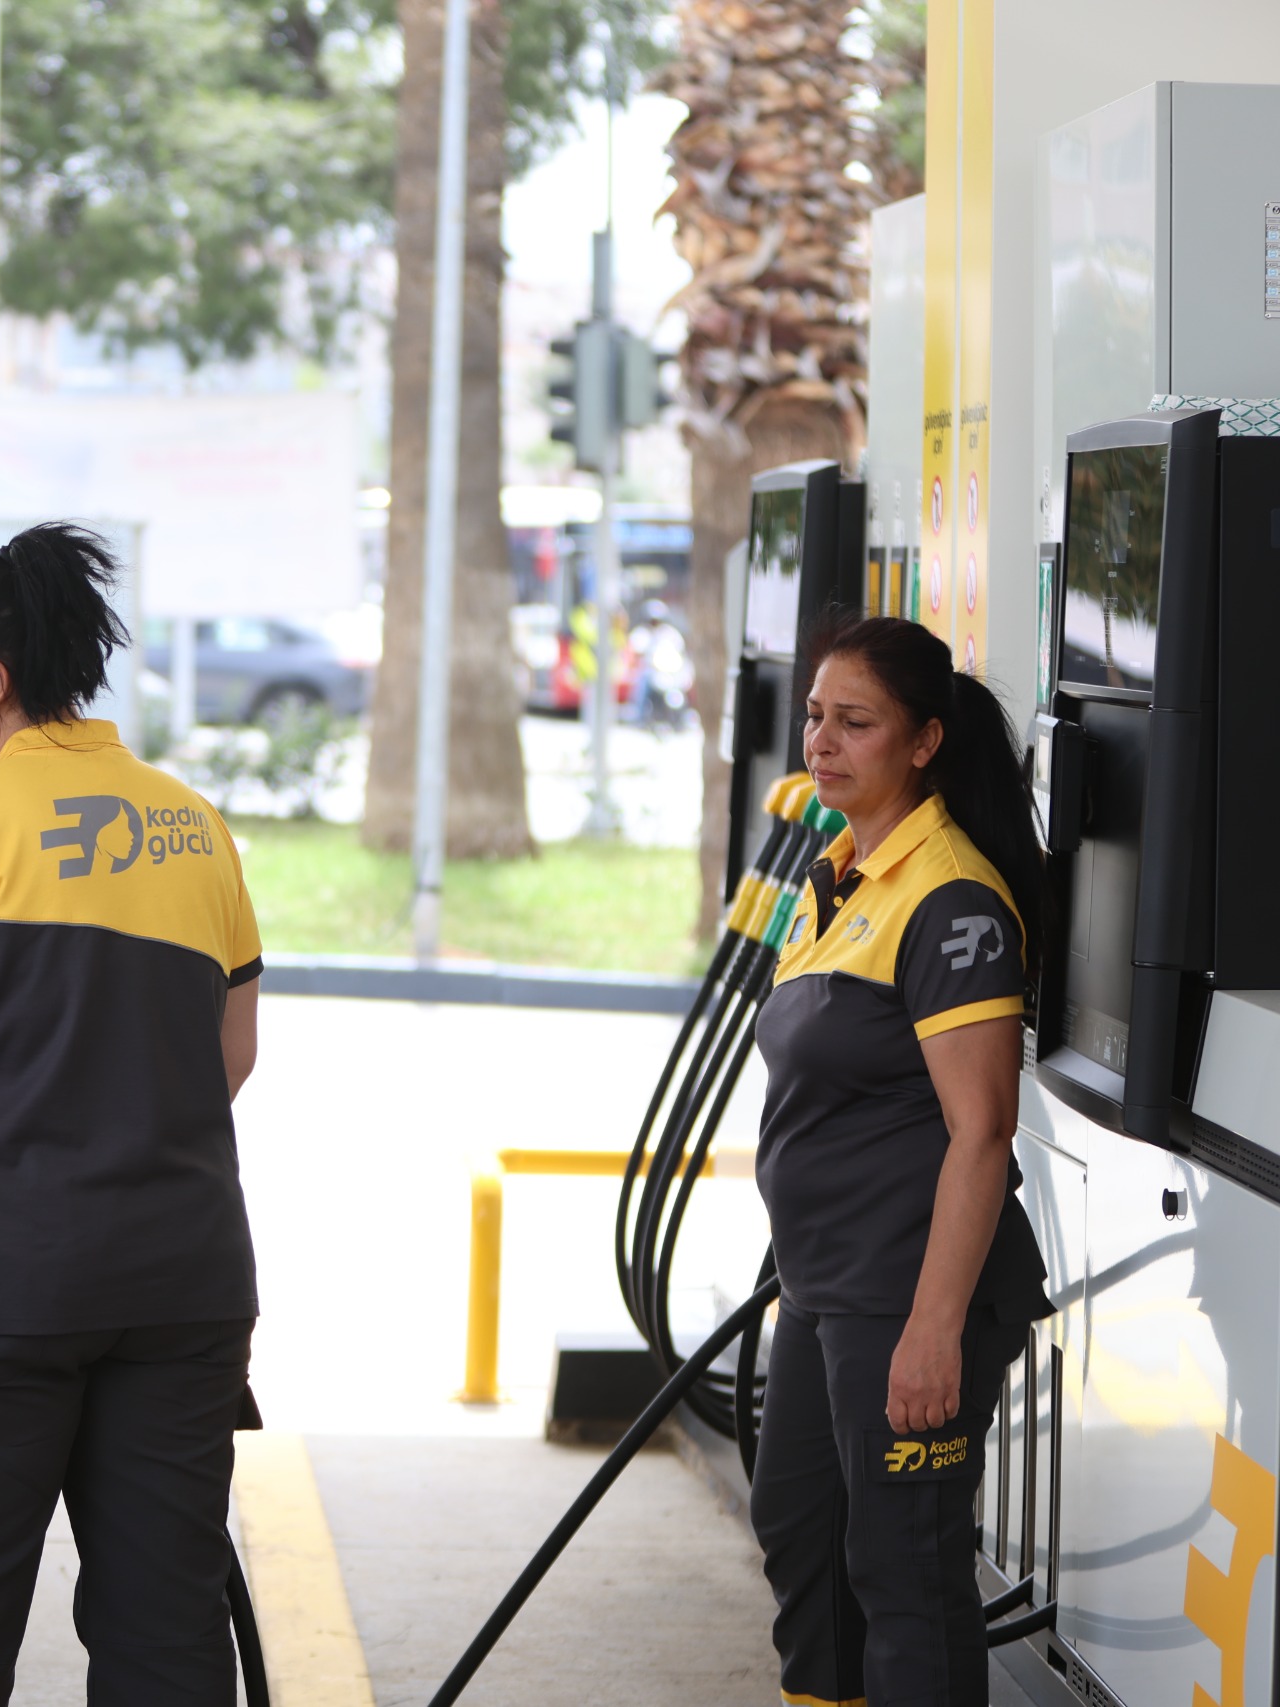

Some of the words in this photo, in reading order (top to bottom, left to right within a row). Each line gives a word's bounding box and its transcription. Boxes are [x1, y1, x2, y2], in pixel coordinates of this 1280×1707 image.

[145, 805, 209, 829] kadın
[148, 828, 213, 865] gücü
[929, 1436, 968, 1455] kadın
[932, 1448, 967, 1470] gücü
